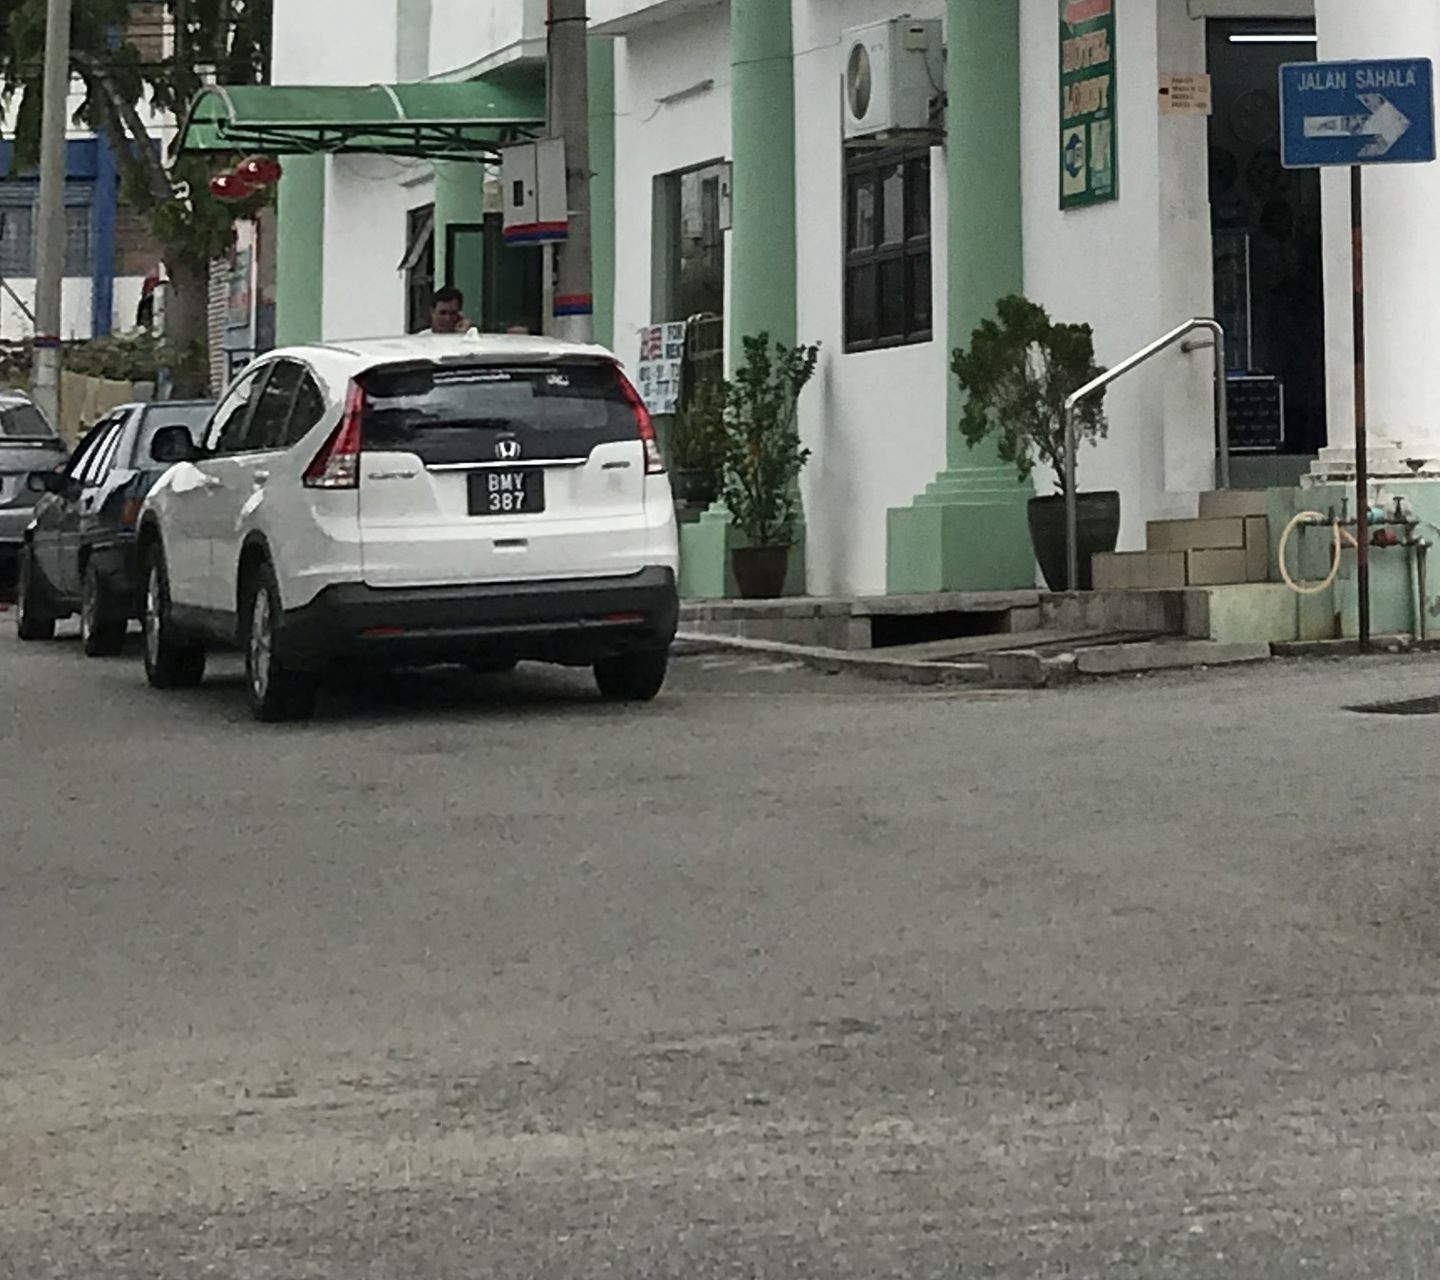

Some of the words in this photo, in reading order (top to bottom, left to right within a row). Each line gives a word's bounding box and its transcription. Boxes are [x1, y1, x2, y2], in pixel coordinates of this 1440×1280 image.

[1297, 70, 1347, 92] JALAN
[1354, 67, 1417, 90] SAHALA
[487, 472, 525, 492] BMY
[488, 491, 526, 512] 387
